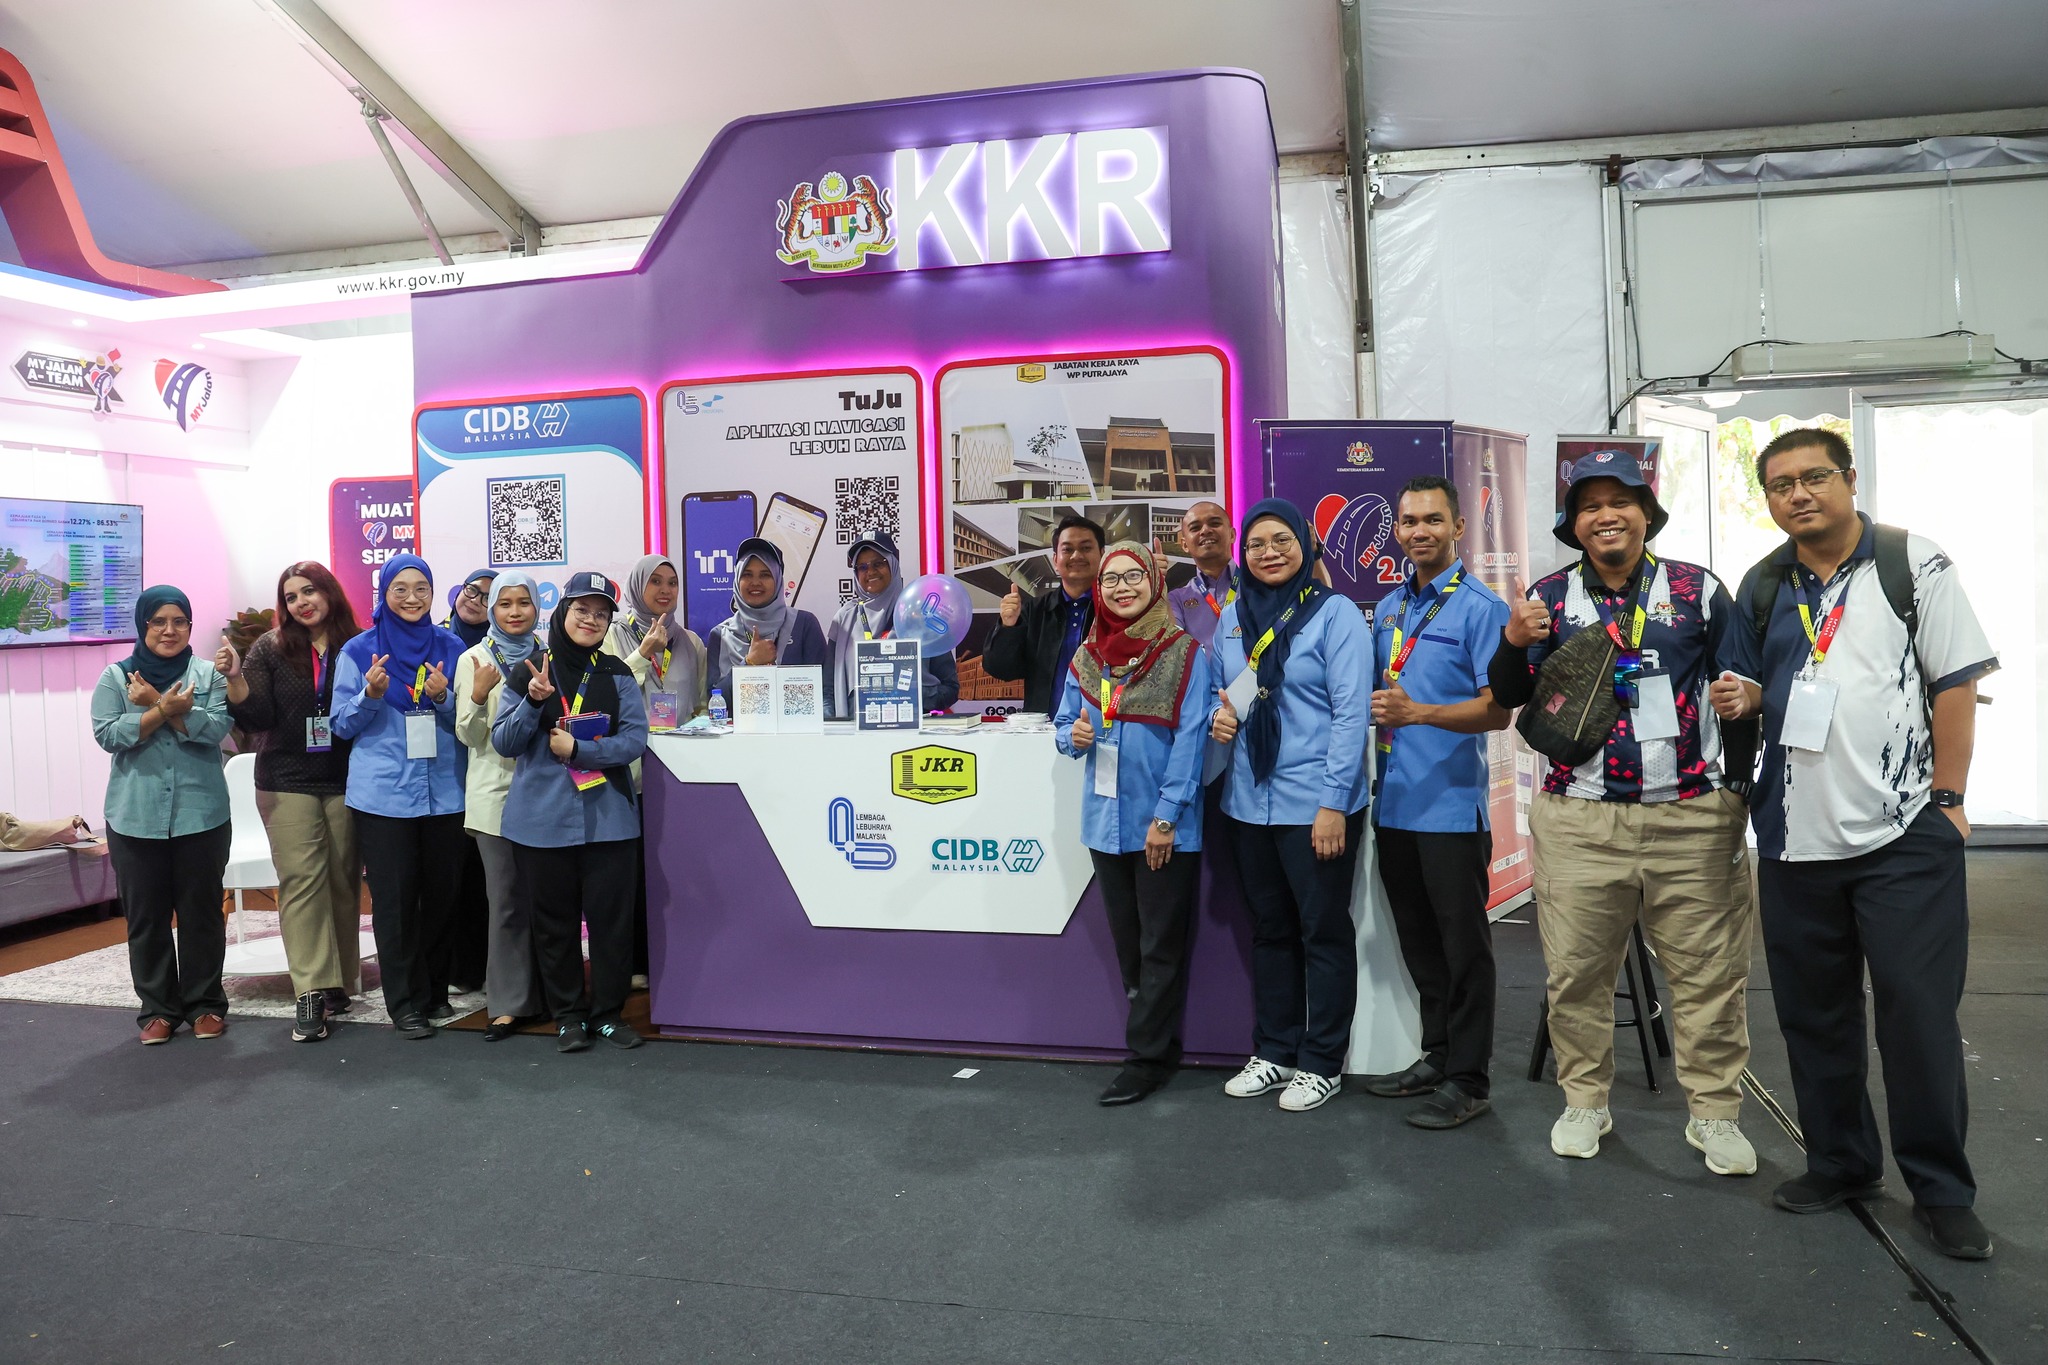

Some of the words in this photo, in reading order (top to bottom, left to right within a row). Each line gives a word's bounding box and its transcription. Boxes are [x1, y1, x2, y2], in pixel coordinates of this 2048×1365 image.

[895, 127, 1169, 270] KKR
[337, 271, 465, 294] www.kkr.gov.my
[27, 357, 83, 376] MYJALAN
[1053, 361, 1089, 370] JABATAN
[1090, 360, 1116, 368] KERJA
[1118, 358, 1139, 366] RAYA
[48, 371, 84, 388] TEAM
[1082, 369, 1128, 378] PUTRAJAYA
[838, 389, 902, 411] TuJu
[463, 405, 530, 434] CIDB
[726, 422, 810, 440] APLIKASI
[815, 417, 905, 435] NAVIGASI
[464, 432, 531, 444] MALAYSIA
[790, 439, 850, 456] LEBUH
[855, 436, 906, 452] RAYA
[361, 502, 414, 519] MUAT
[70, 518, 91, 526] 12.27%
[97, 519, 118, 527] 86.53%
[1358, 503, 1393, 568] MYJalan
[919, 757, 964, 773] JKR
[856, 823, 892, 831] LEBUHRAYA
[856, 833, 887, 841] MALAYSIA
[931, 838, 999, 861] CIDB
[931, 863, 1000, 872] MALAYSIA
